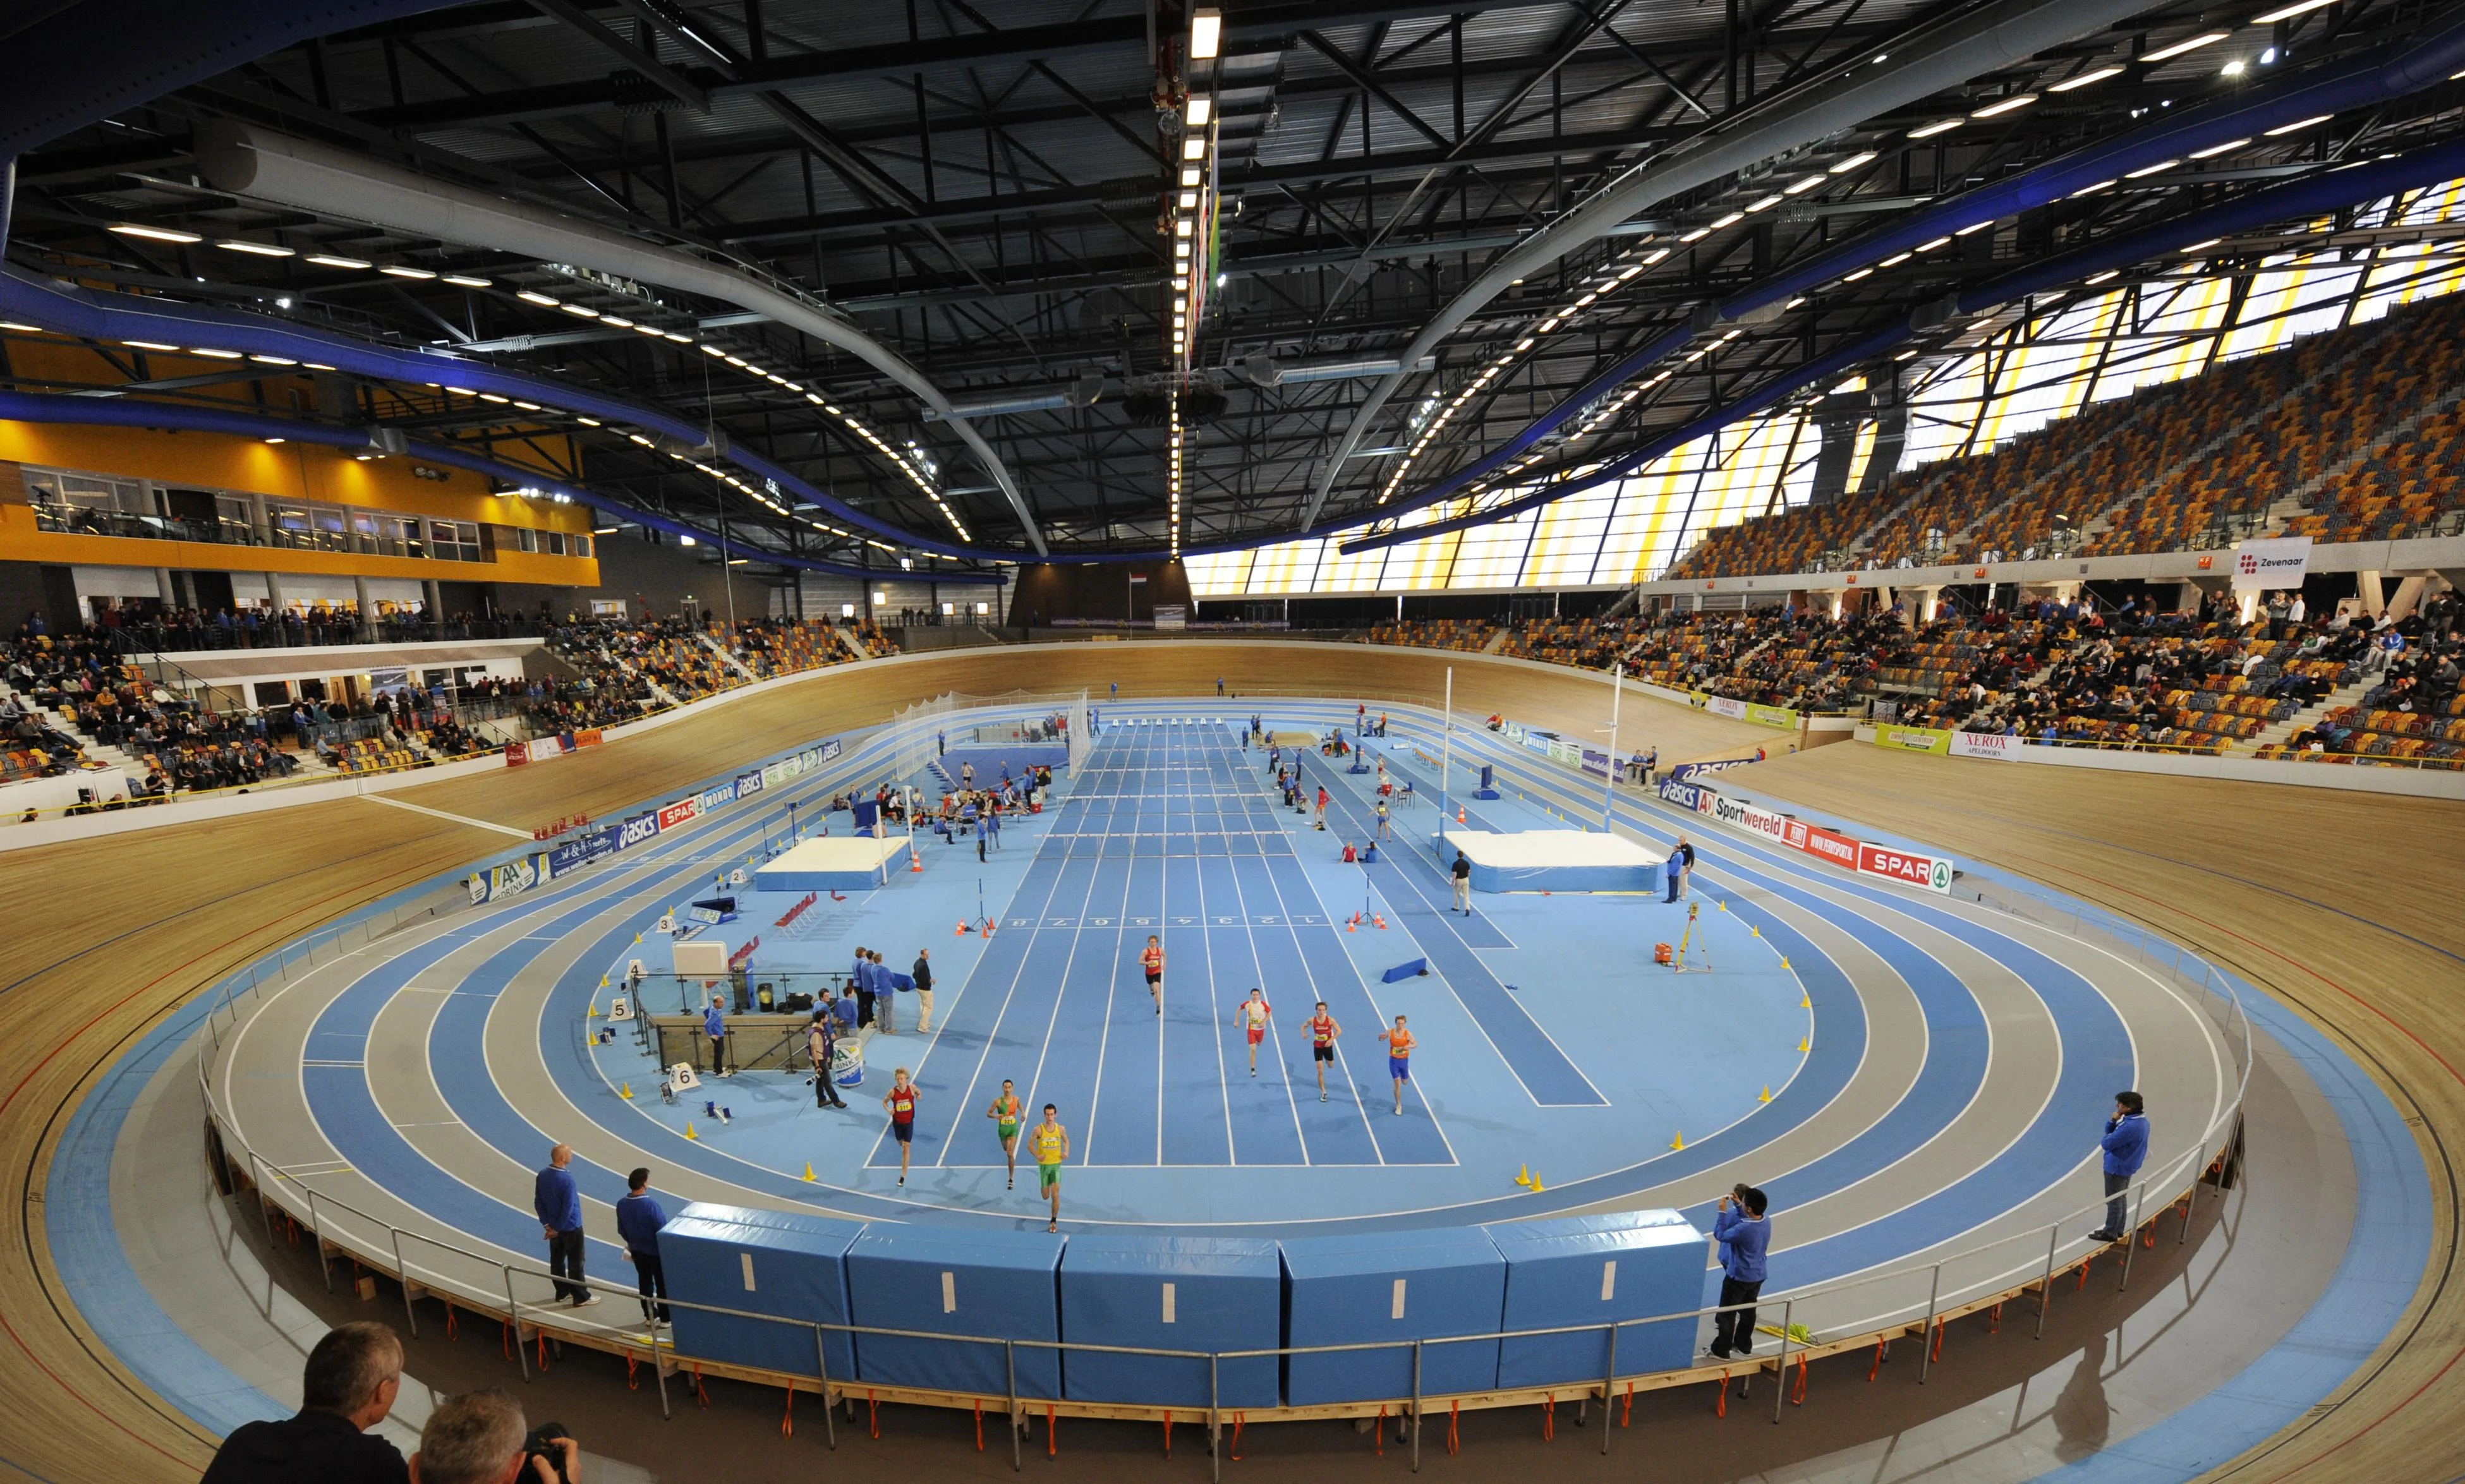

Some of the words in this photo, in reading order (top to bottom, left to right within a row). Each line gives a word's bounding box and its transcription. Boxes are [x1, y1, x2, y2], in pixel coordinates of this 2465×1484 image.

[2261, 558, 2303, 567] Zevenaar
[1965, 733, 2008, 749] XEROX
[1968, 748, 2001, 756] APELDOORN
[705, 785, 734, 808] MONDO
[1699, 792, 1716, 816] AD
[667, 803, 695, 824] SPAR
[1716, 797, 1781, 836] Sportwereld
[1874, 854, 1930, 881] SPAR
[503, 866, 520, 888] AA
[734, 872, 739, 881] 2
[501, 880, 524, 898] DRINK
[661, 920, 668, 929] 3
[631, 965, 639, 976] 4
[615, 1004, 624, 1016] 5
[679, 1070, 690, 1084] 6
